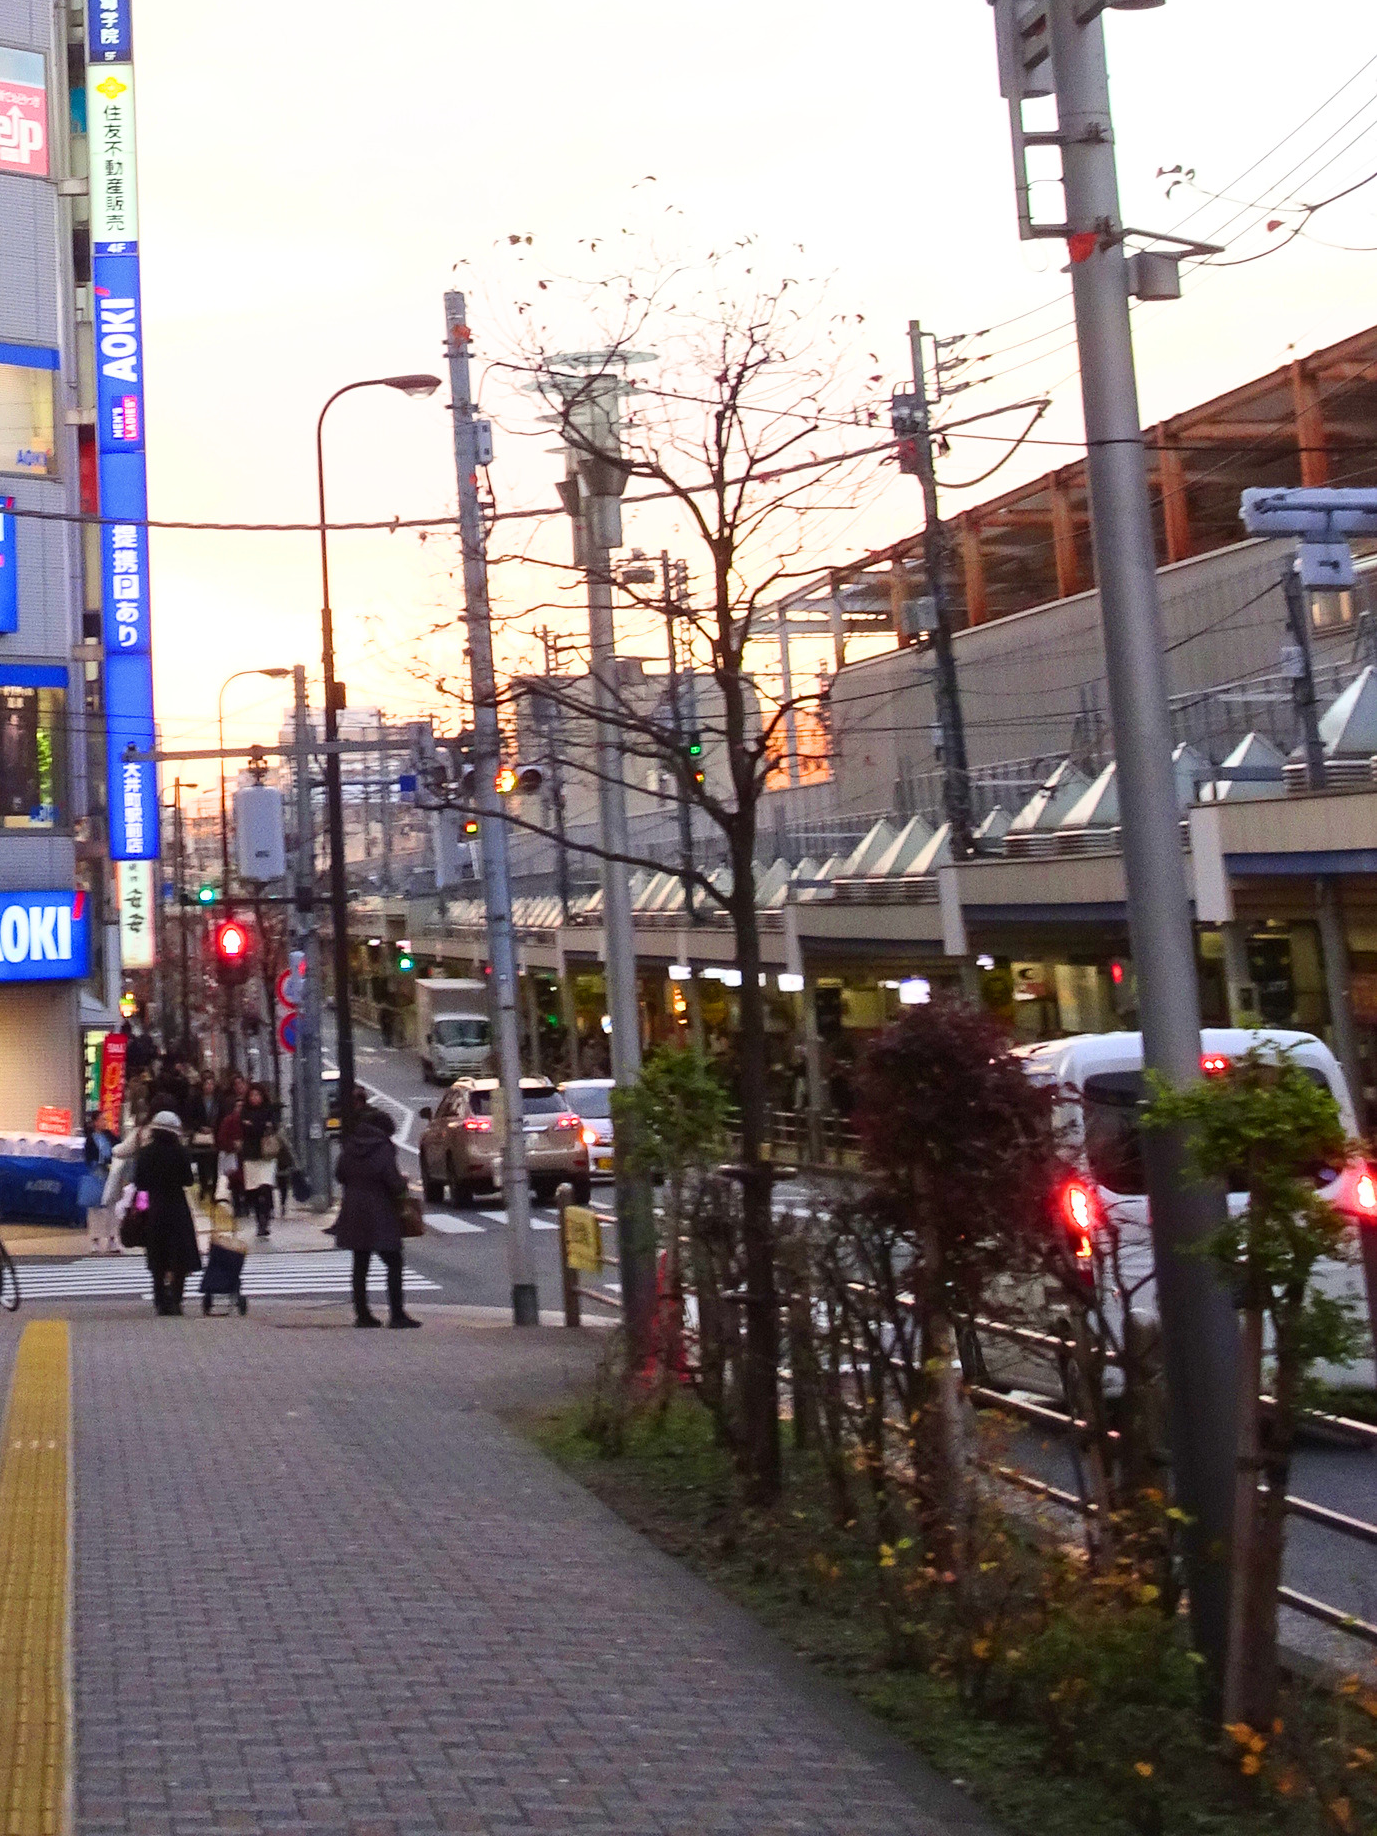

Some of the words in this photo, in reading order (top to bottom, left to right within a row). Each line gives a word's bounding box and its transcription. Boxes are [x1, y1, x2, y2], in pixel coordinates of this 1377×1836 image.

[103, 104, 125, 232] 住友不動産販売
[100, 297, 139, 384] AOKI
[123, 762, 144, 854] 大井町駅前店
